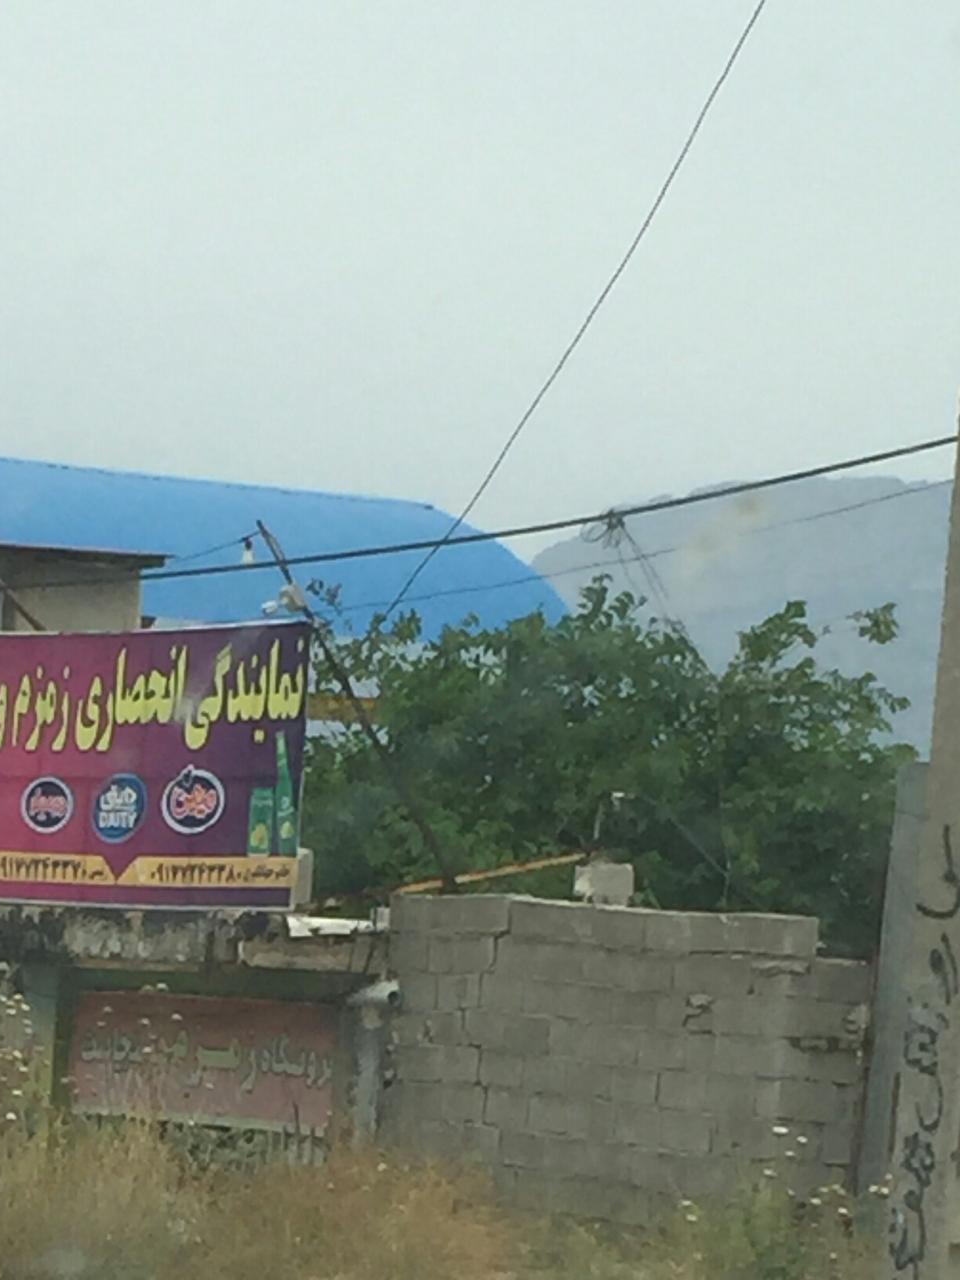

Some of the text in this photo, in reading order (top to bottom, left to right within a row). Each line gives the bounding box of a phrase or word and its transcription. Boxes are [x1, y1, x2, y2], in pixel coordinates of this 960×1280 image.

[11, 665, 71, 752] زمزم
[75, 644, 188, 752] انحصاری
[185, 638, 306, 750] نمایندگی
